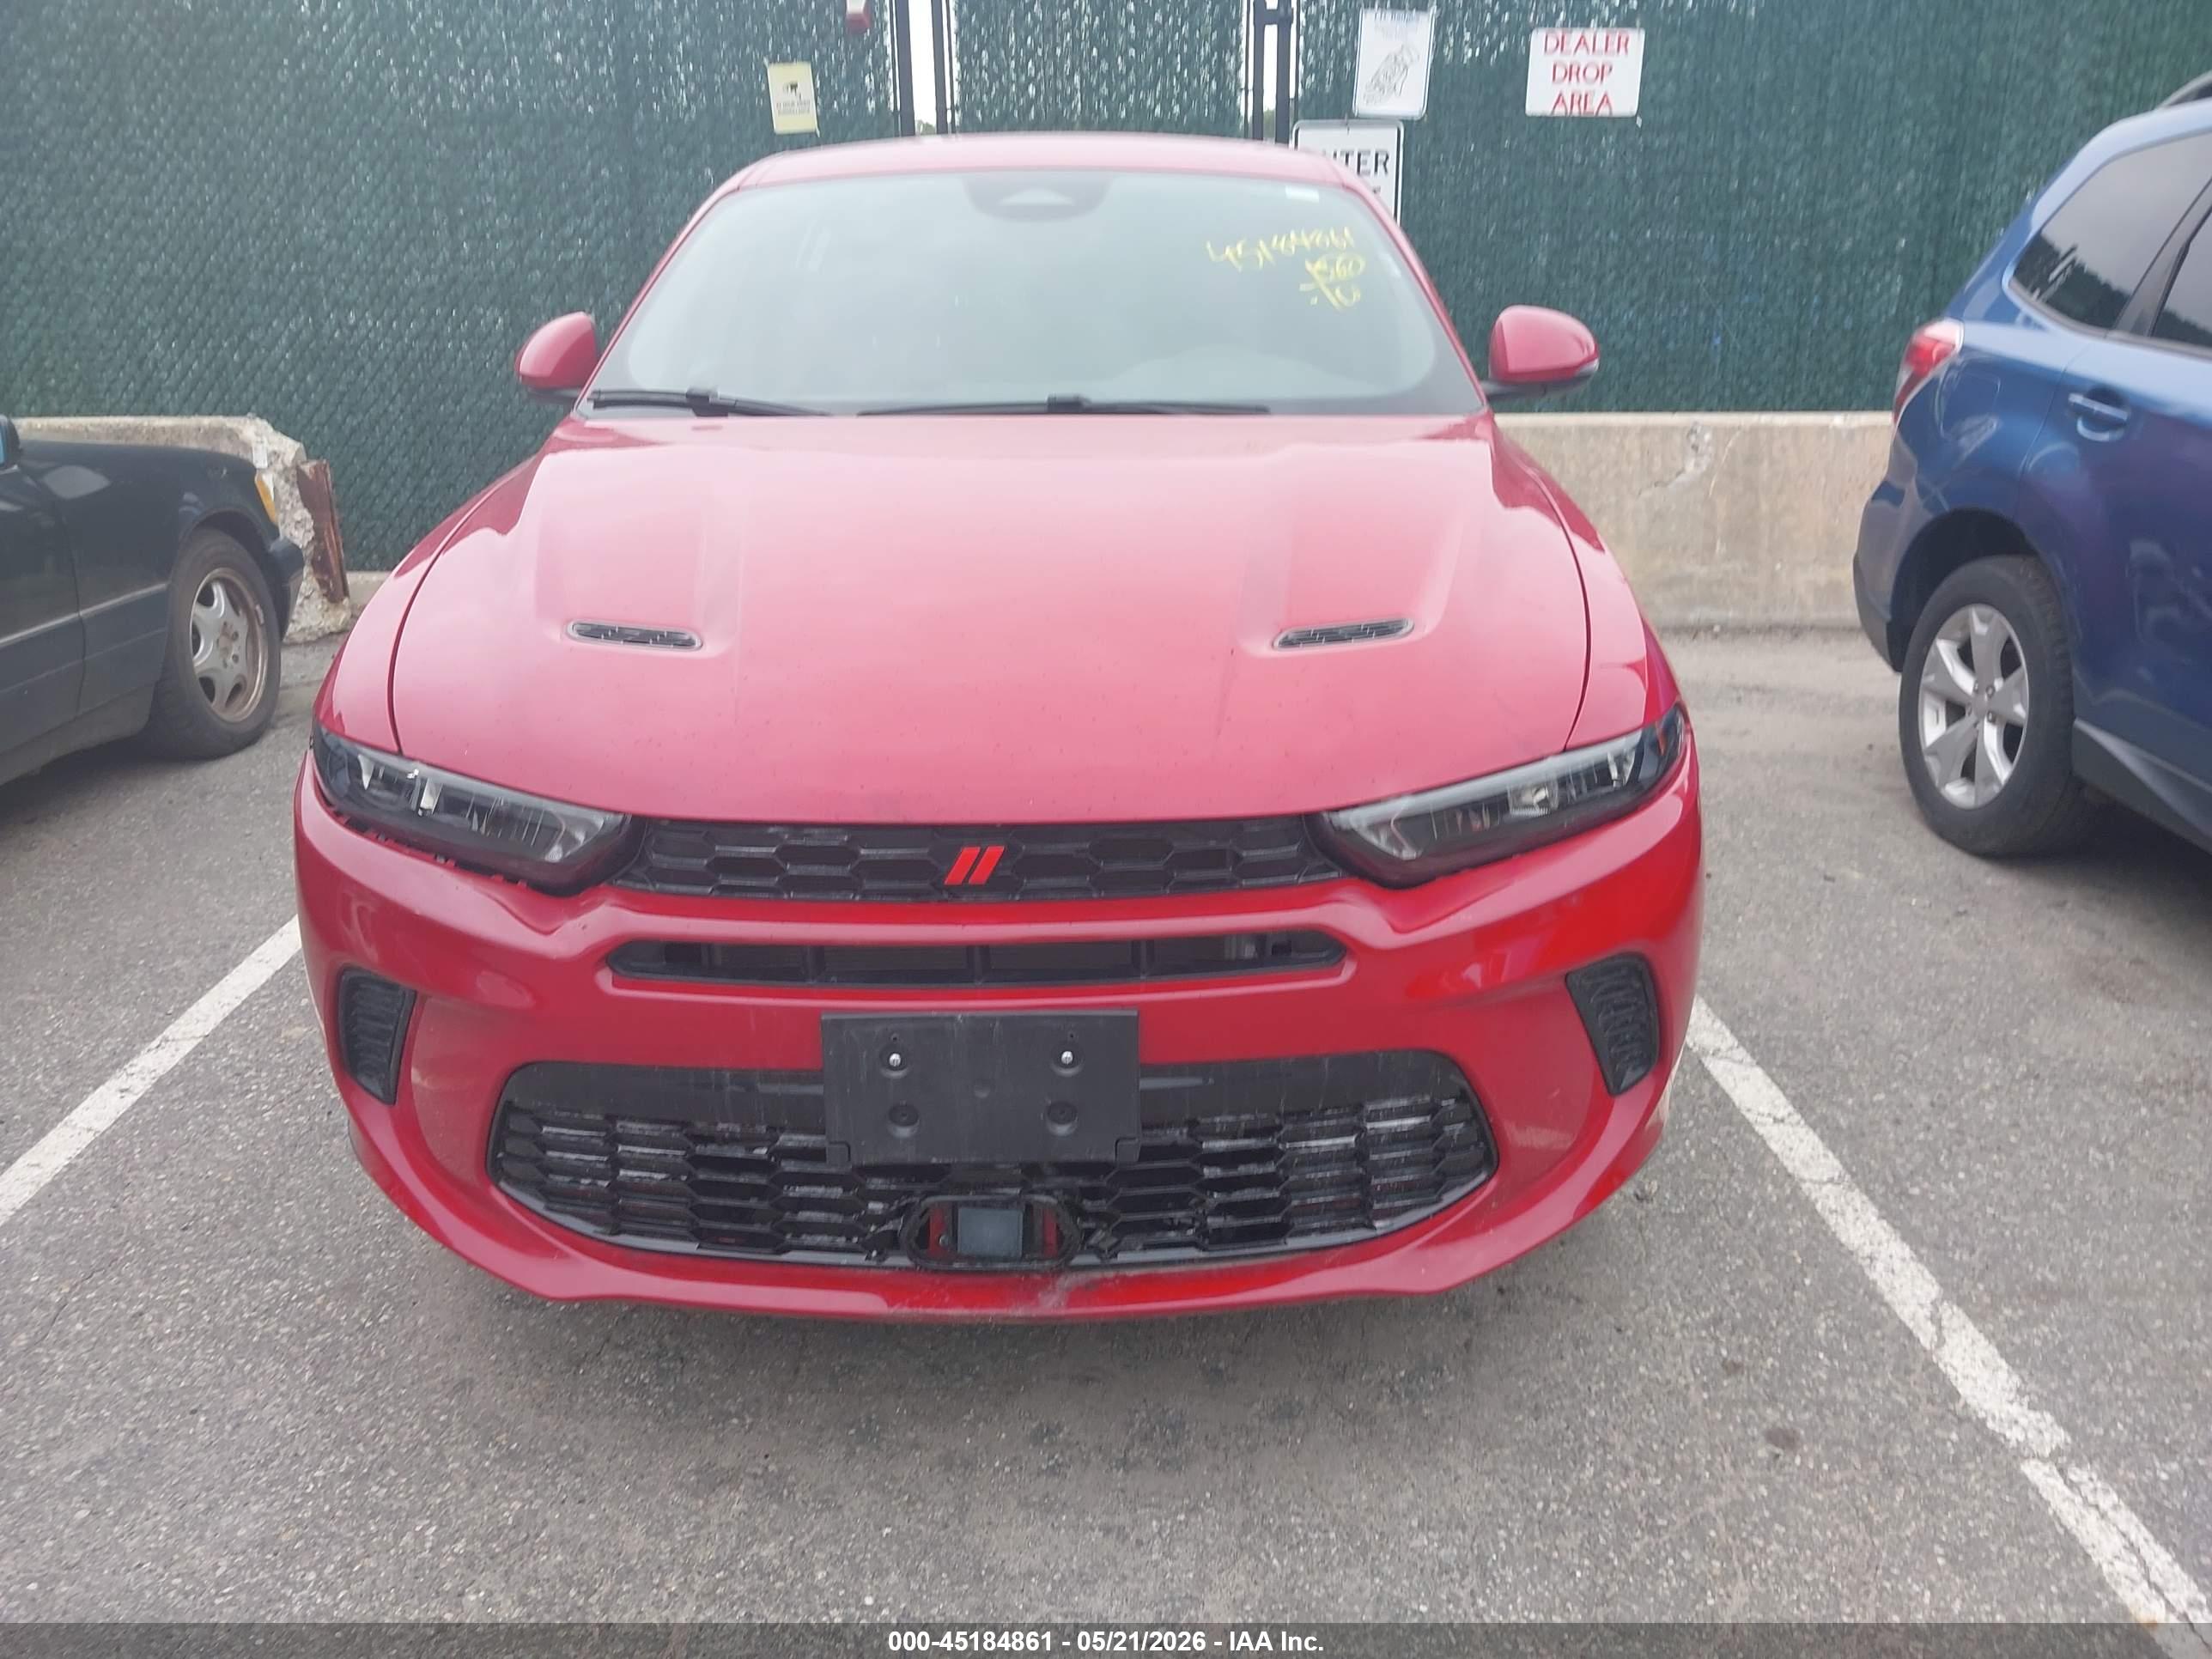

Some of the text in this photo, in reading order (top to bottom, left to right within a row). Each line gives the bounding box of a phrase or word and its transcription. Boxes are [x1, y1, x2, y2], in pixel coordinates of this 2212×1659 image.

[1544, 29, 1630, 55] DEALER
[1552, 61, 1613, 84] DROP
[1550, 90, 1613, 116] AREA
